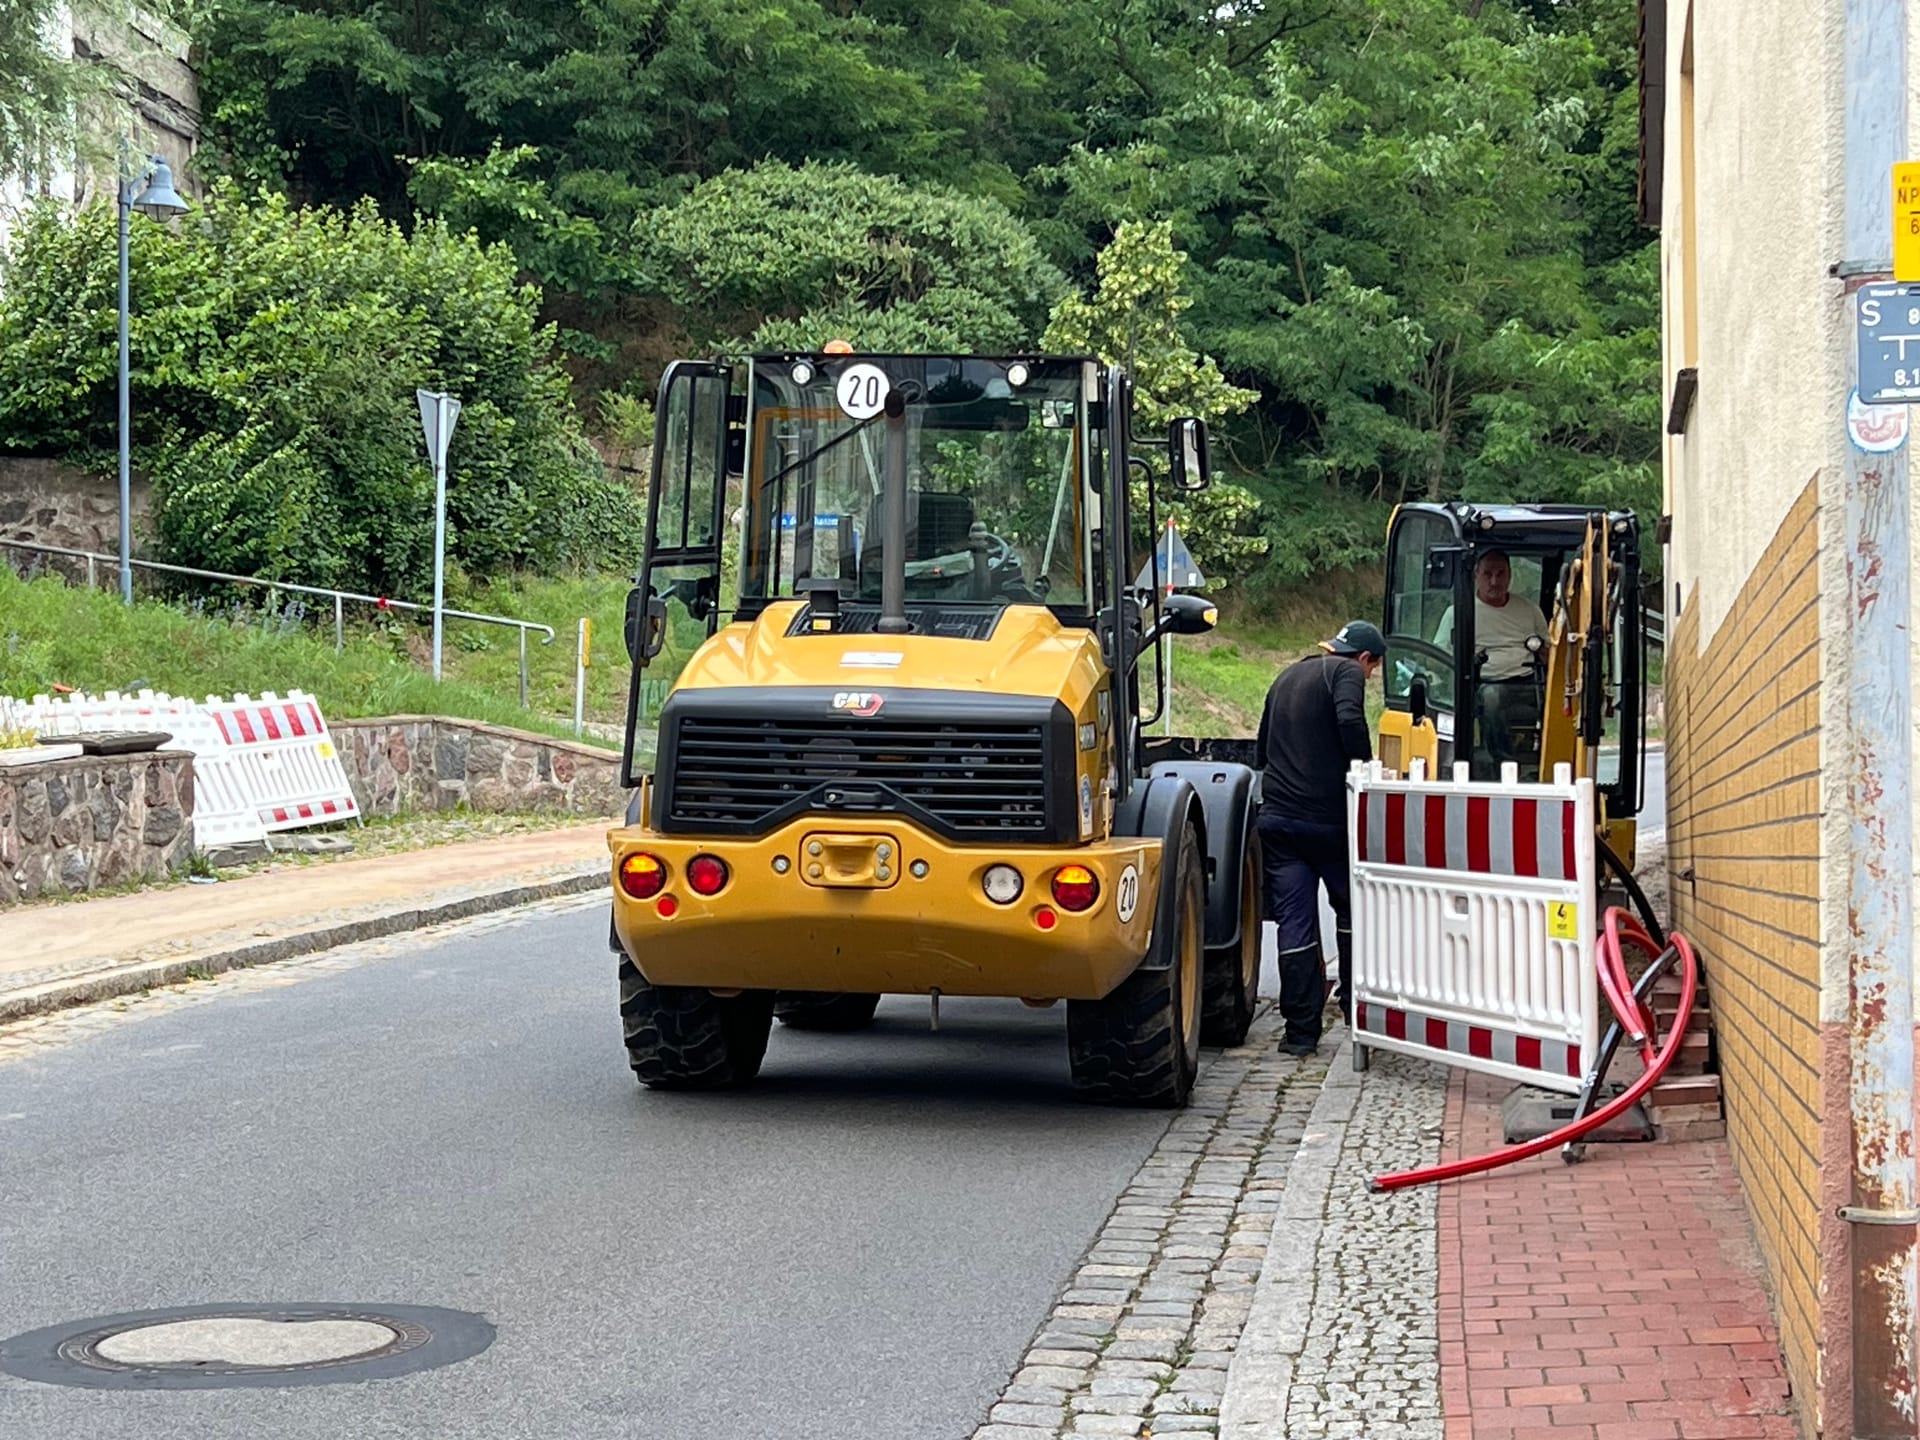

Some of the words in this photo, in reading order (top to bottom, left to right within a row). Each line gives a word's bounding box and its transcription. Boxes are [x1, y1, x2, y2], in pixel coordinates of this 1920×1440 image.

[1861, 300, 1881, 327] S
[848, 375, 879, 408] 20
[833, 692, 873, 709] CAT
[1120, 876, 1135, 912] 20
